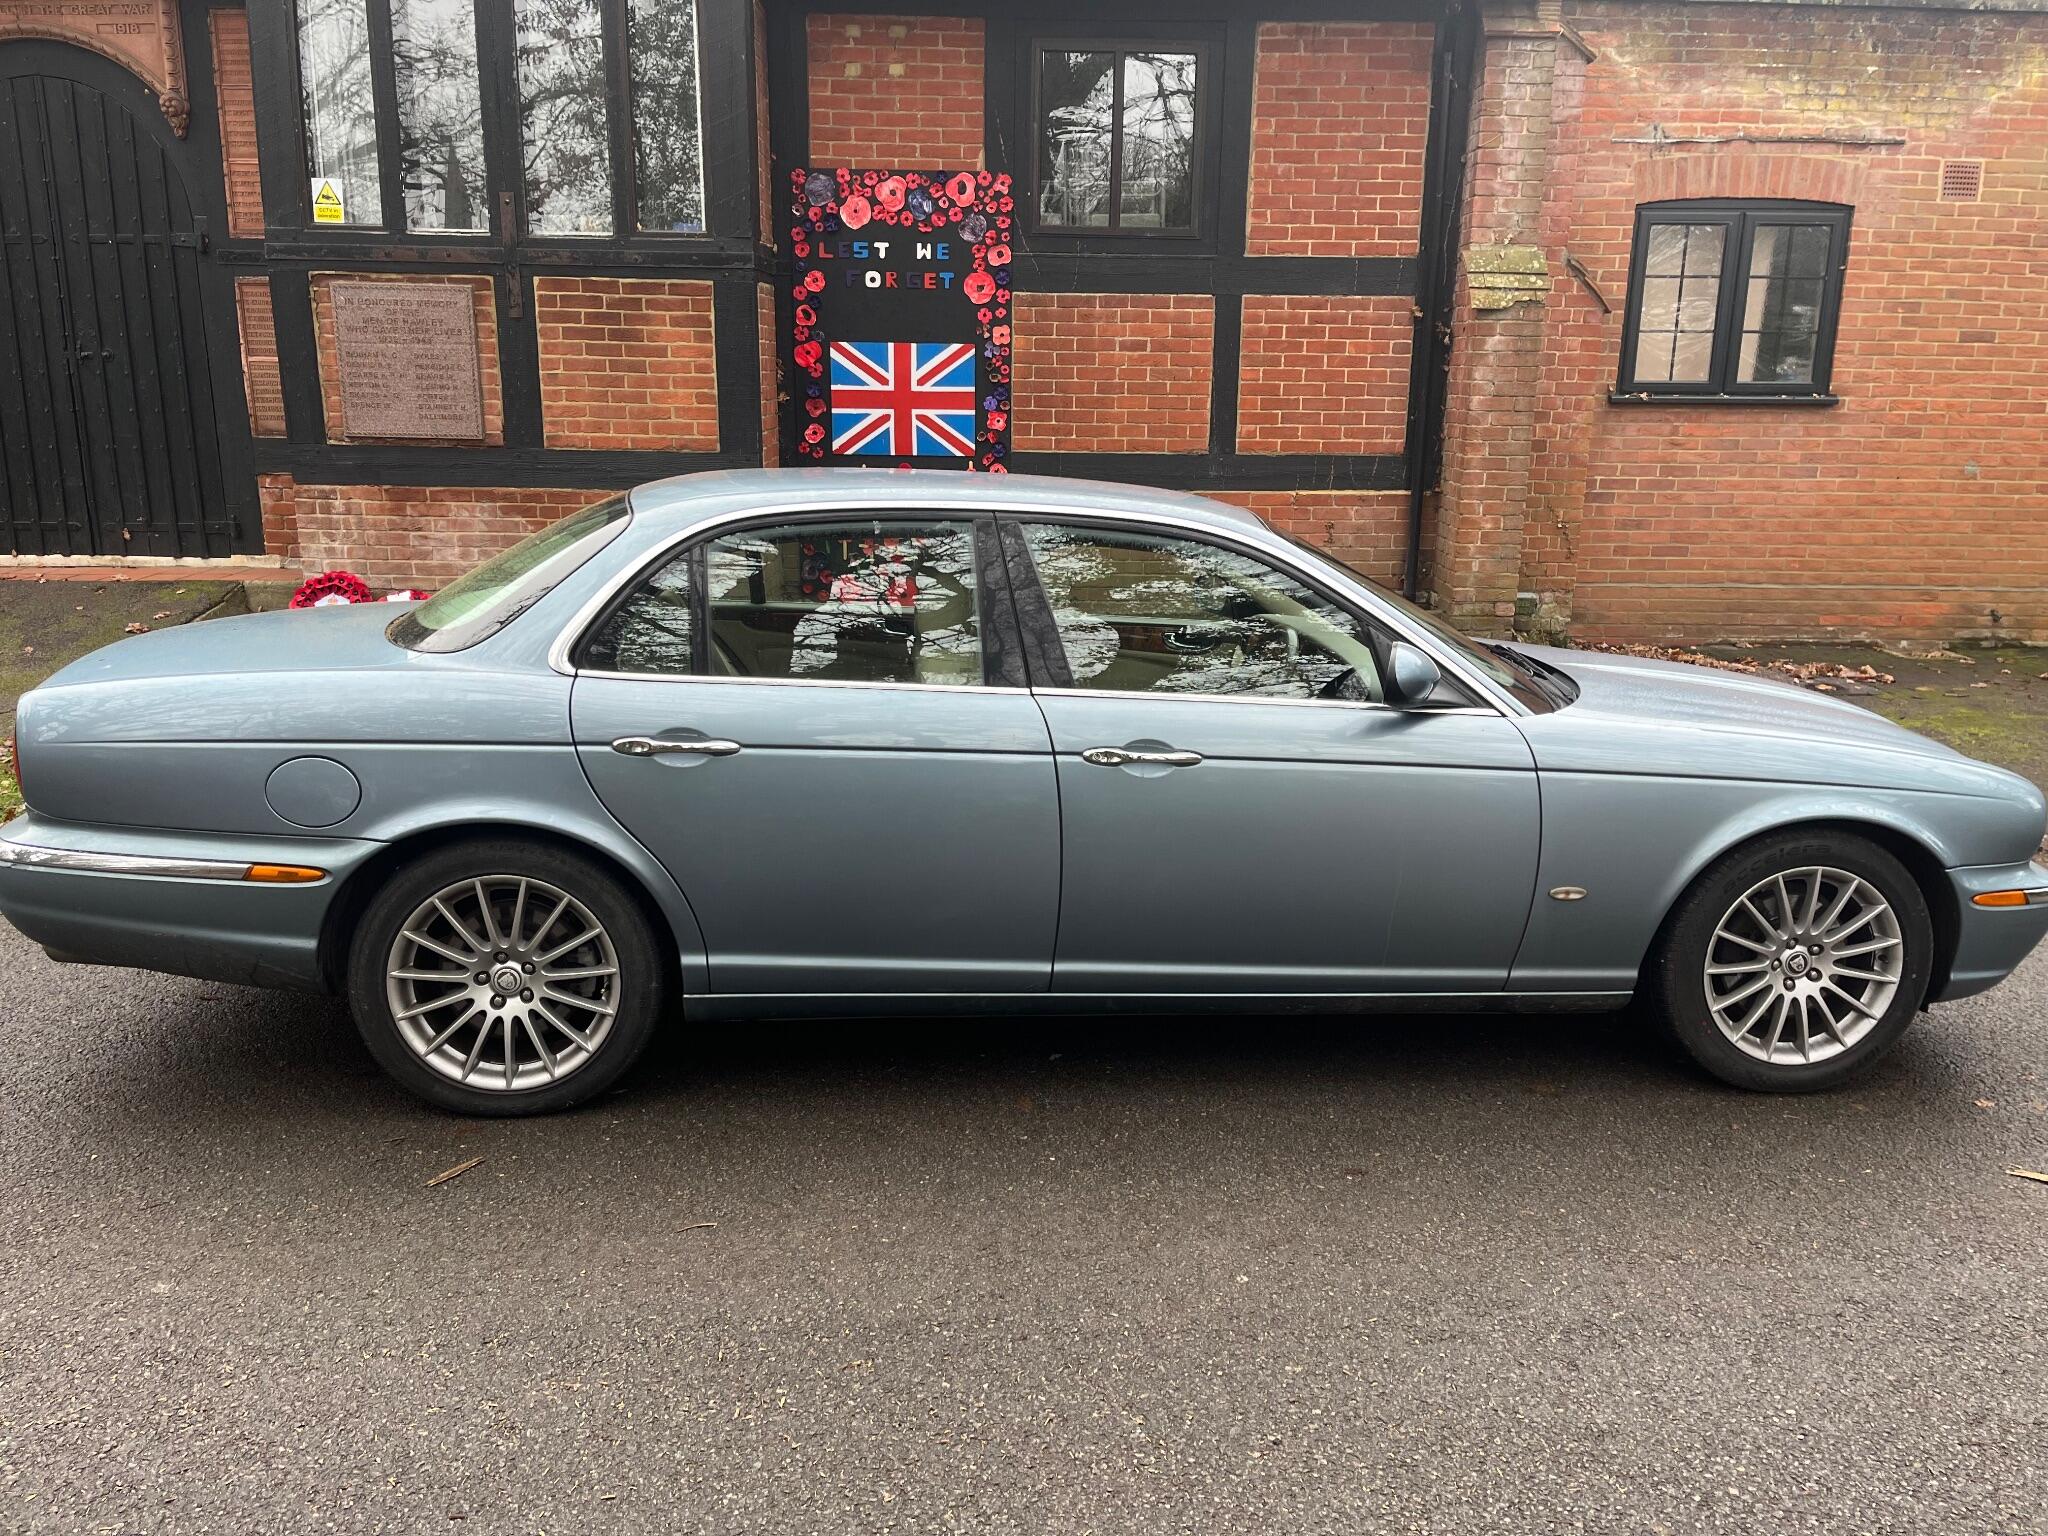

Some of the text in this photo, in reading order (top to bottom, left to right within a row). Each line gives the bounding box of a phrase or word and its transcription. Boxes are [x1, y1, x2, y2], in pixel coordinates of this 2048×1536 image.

[40, 5, 63, 15] THE
[71, 5, 112, 15] GREAT
[119, 4, 150, 15] WAR
[113, 23, 140, 34] 1918
[818, 241, 950, 260] LEST WE
[845, 270, 955, 290] FORGET
[344, 298, 459, 308] IN HONOURED MEMORY
[385, 308, 399, 316] OF
[362, 317, 383, 326] MEN
[386, 317, 399, 326] OF
[346, 325, 369, 334] WHO
[372, 326, 399, 335] GAVE
[434, 328, 462, 336] LIVES
